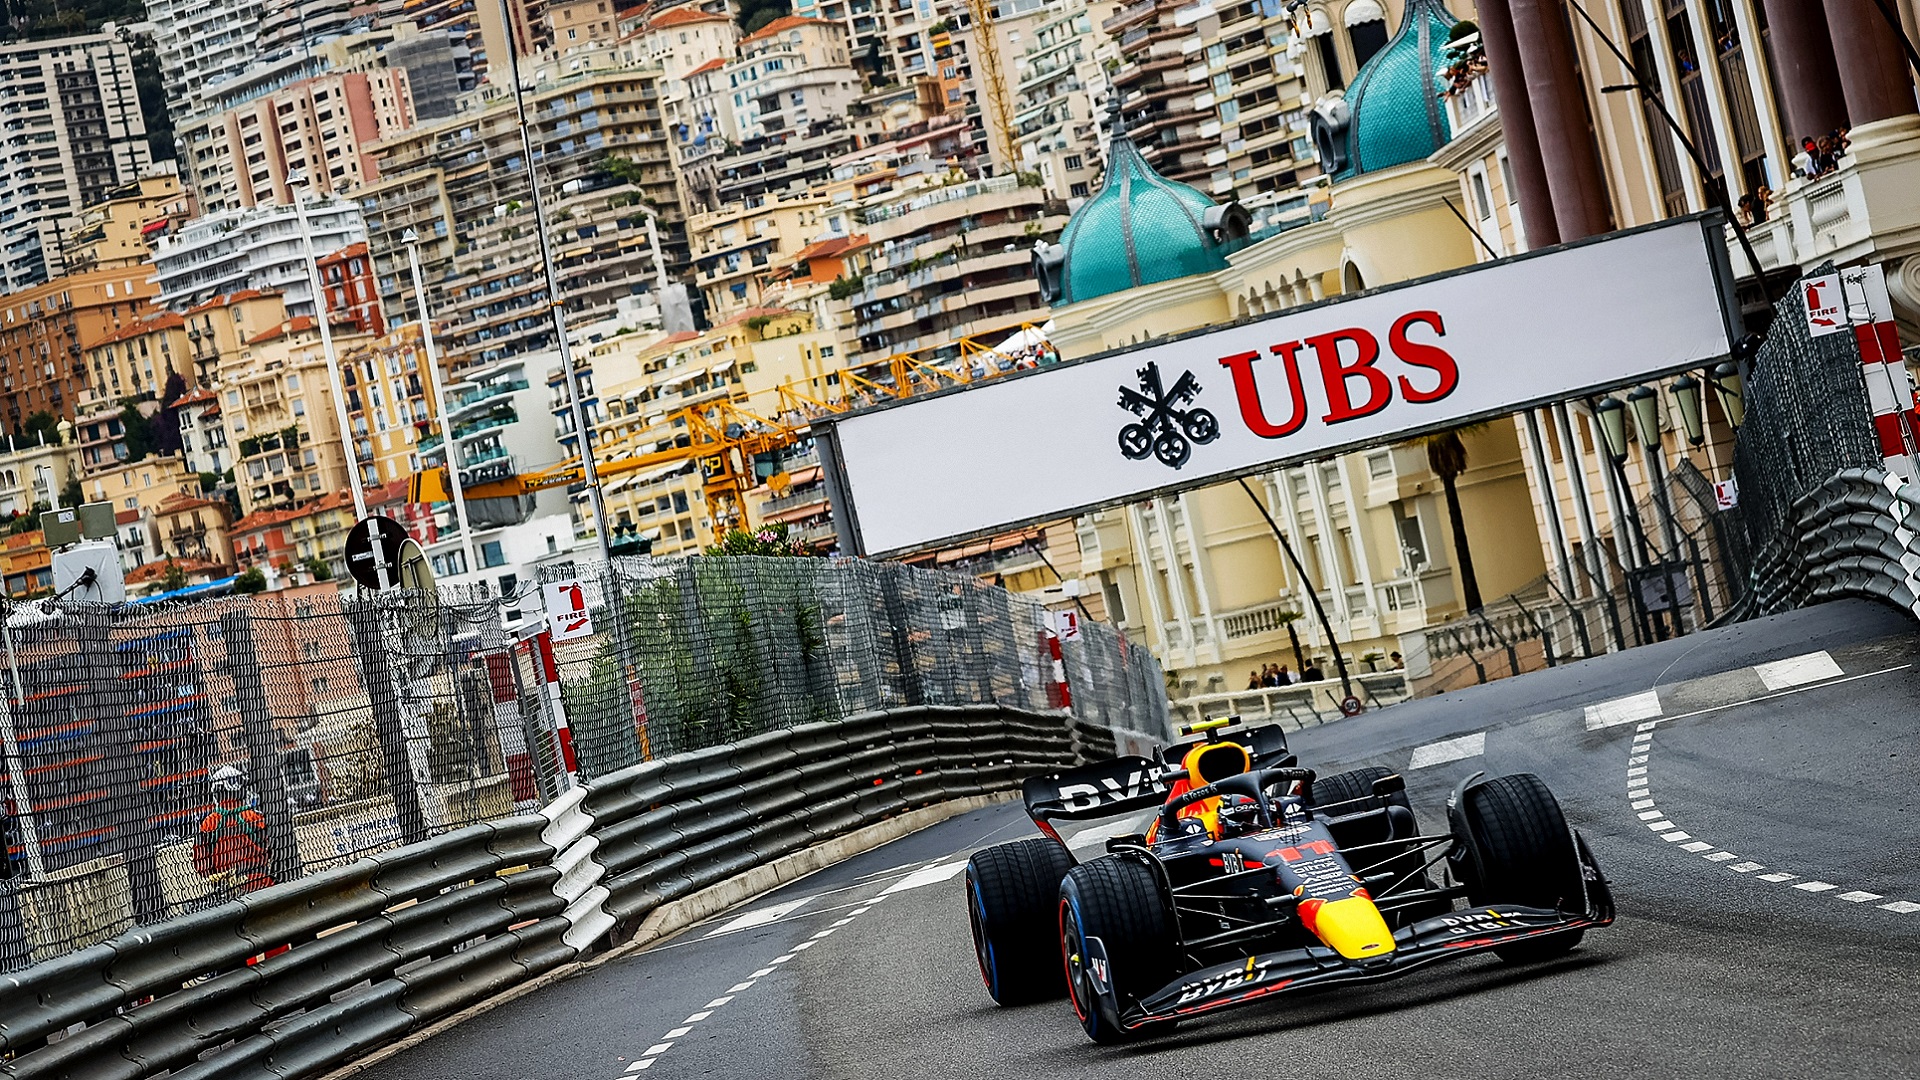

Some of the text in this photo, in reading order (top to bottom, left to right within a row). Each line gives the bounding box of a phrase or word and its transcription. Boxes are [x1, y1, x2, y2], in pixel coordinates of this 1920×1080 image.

[1809, 307, 1838, 319] FIRE
[1218, 310, 1460, 440] UBS
[556, 610, 587, 622] FIRE
[1235, 803, 1261, 812] ORAC
